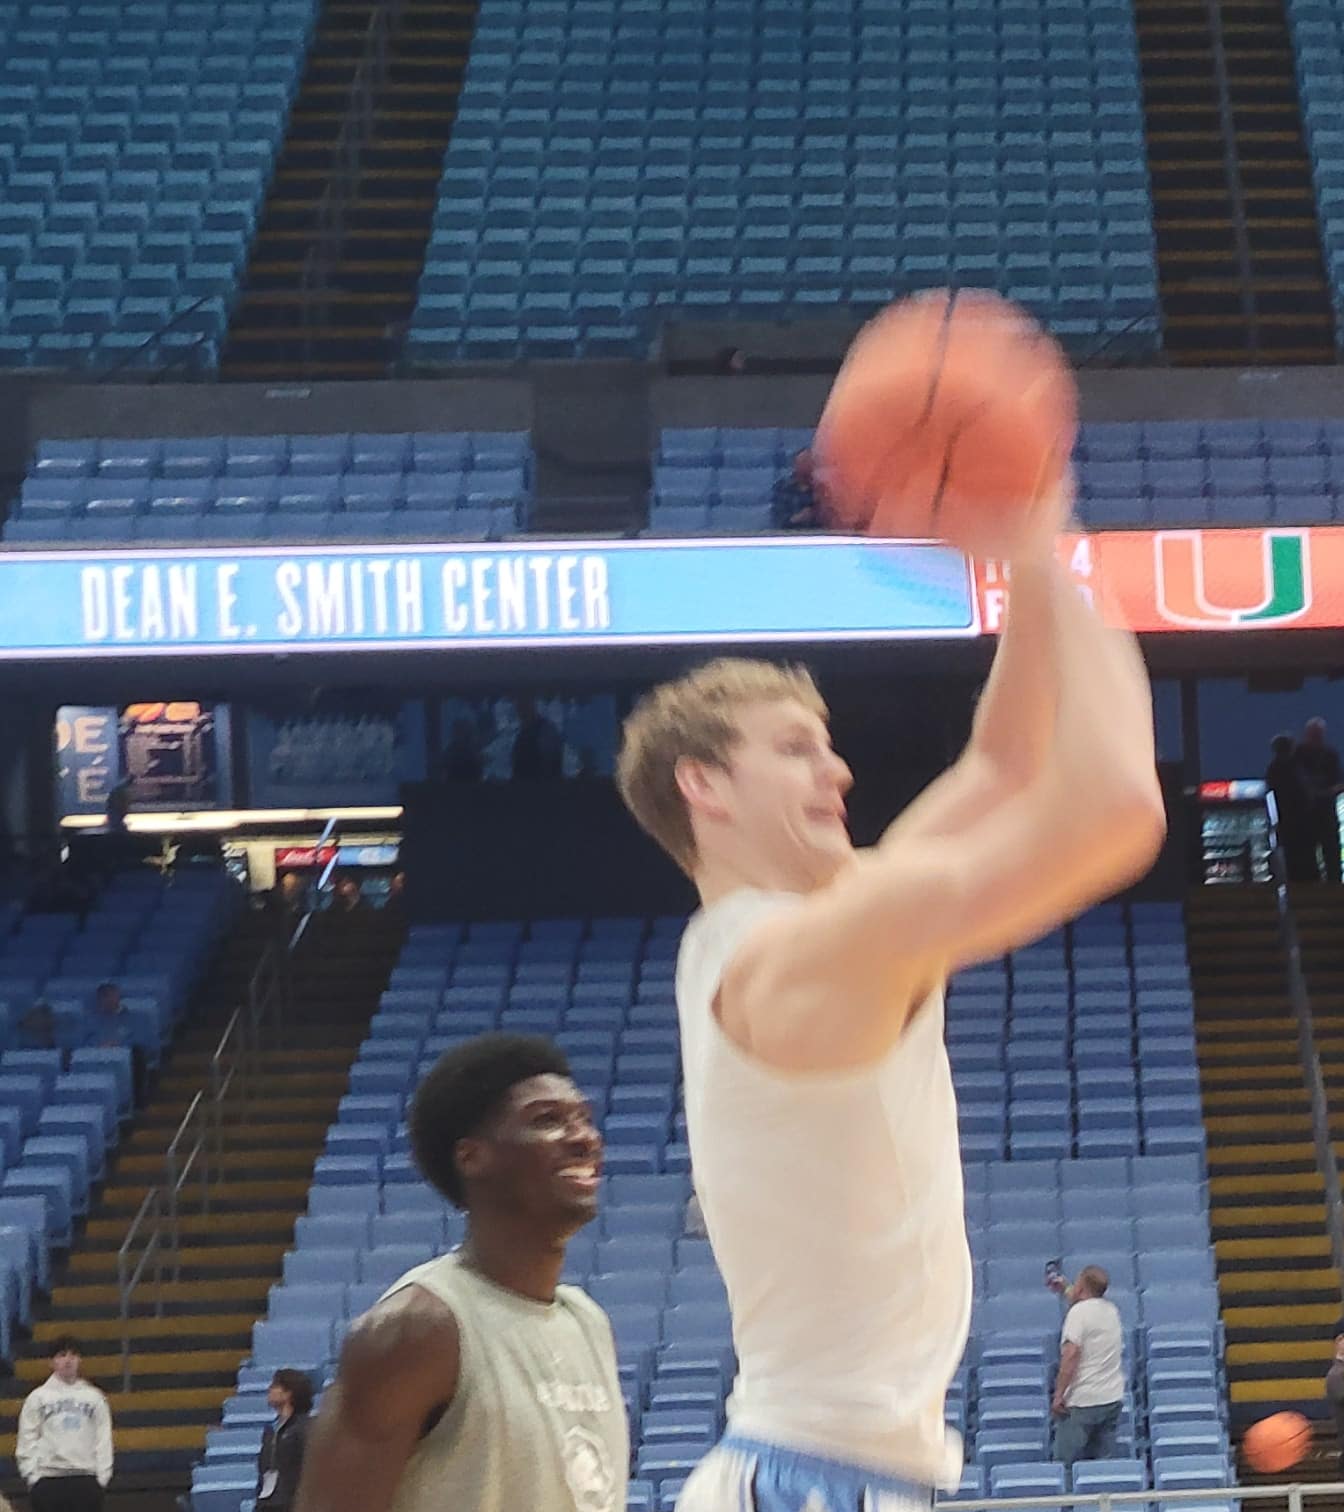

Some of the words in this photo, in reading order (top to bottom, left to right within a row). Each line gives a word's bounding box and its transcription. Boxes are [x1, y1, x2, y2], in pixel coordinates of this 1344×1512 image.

[80, 563, 198, 641] DEAN
[216, 562, 257, 638] E.
[274, 559, 425, 637] SMITH
[442, 555, 611, 633] CENTER
[1154, 529, 1312, 628] U
